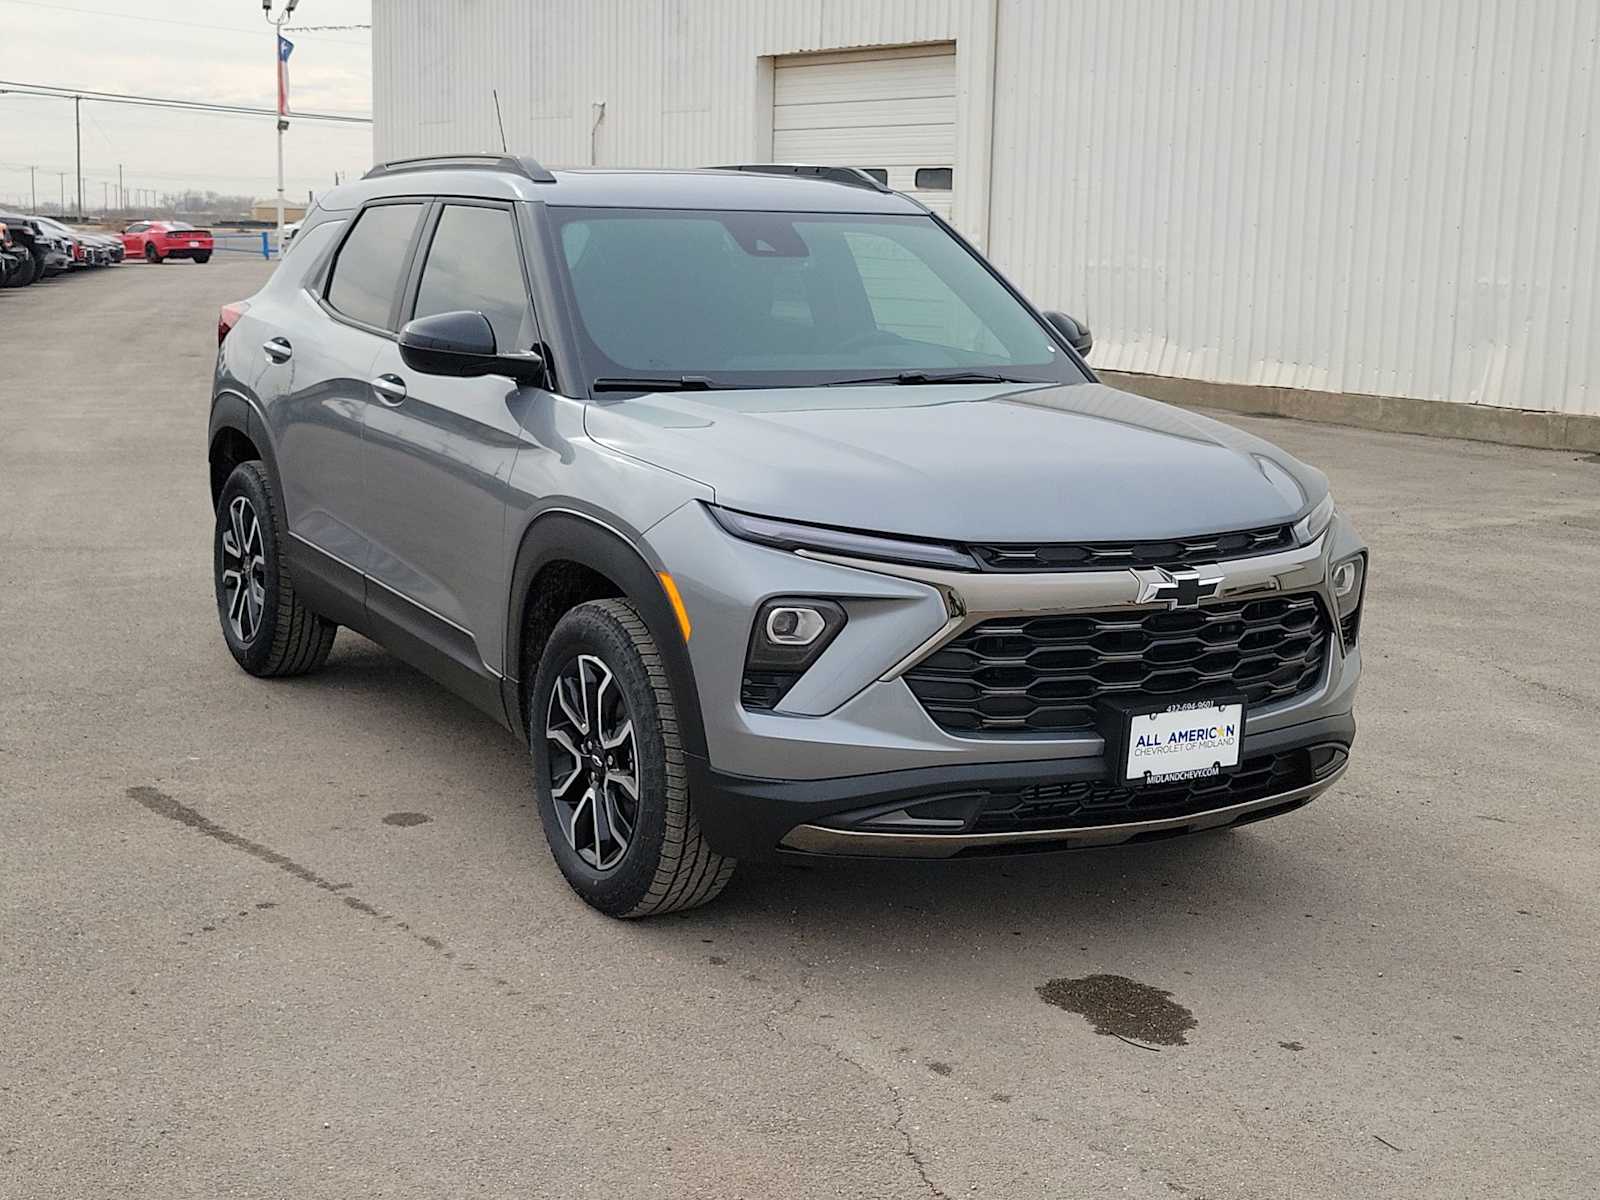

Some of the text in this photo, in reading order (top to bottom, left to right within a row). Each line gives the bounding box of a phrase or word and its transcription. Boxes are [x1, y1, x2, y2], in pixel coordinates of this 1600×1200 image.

[1134, 737, 1235, 757] CHEVROLET OF MIDLAND
[1136, 735, 1161, 747] ALL
[1146, 767, 1220, 784] MIDLANDCHEVY.COM
